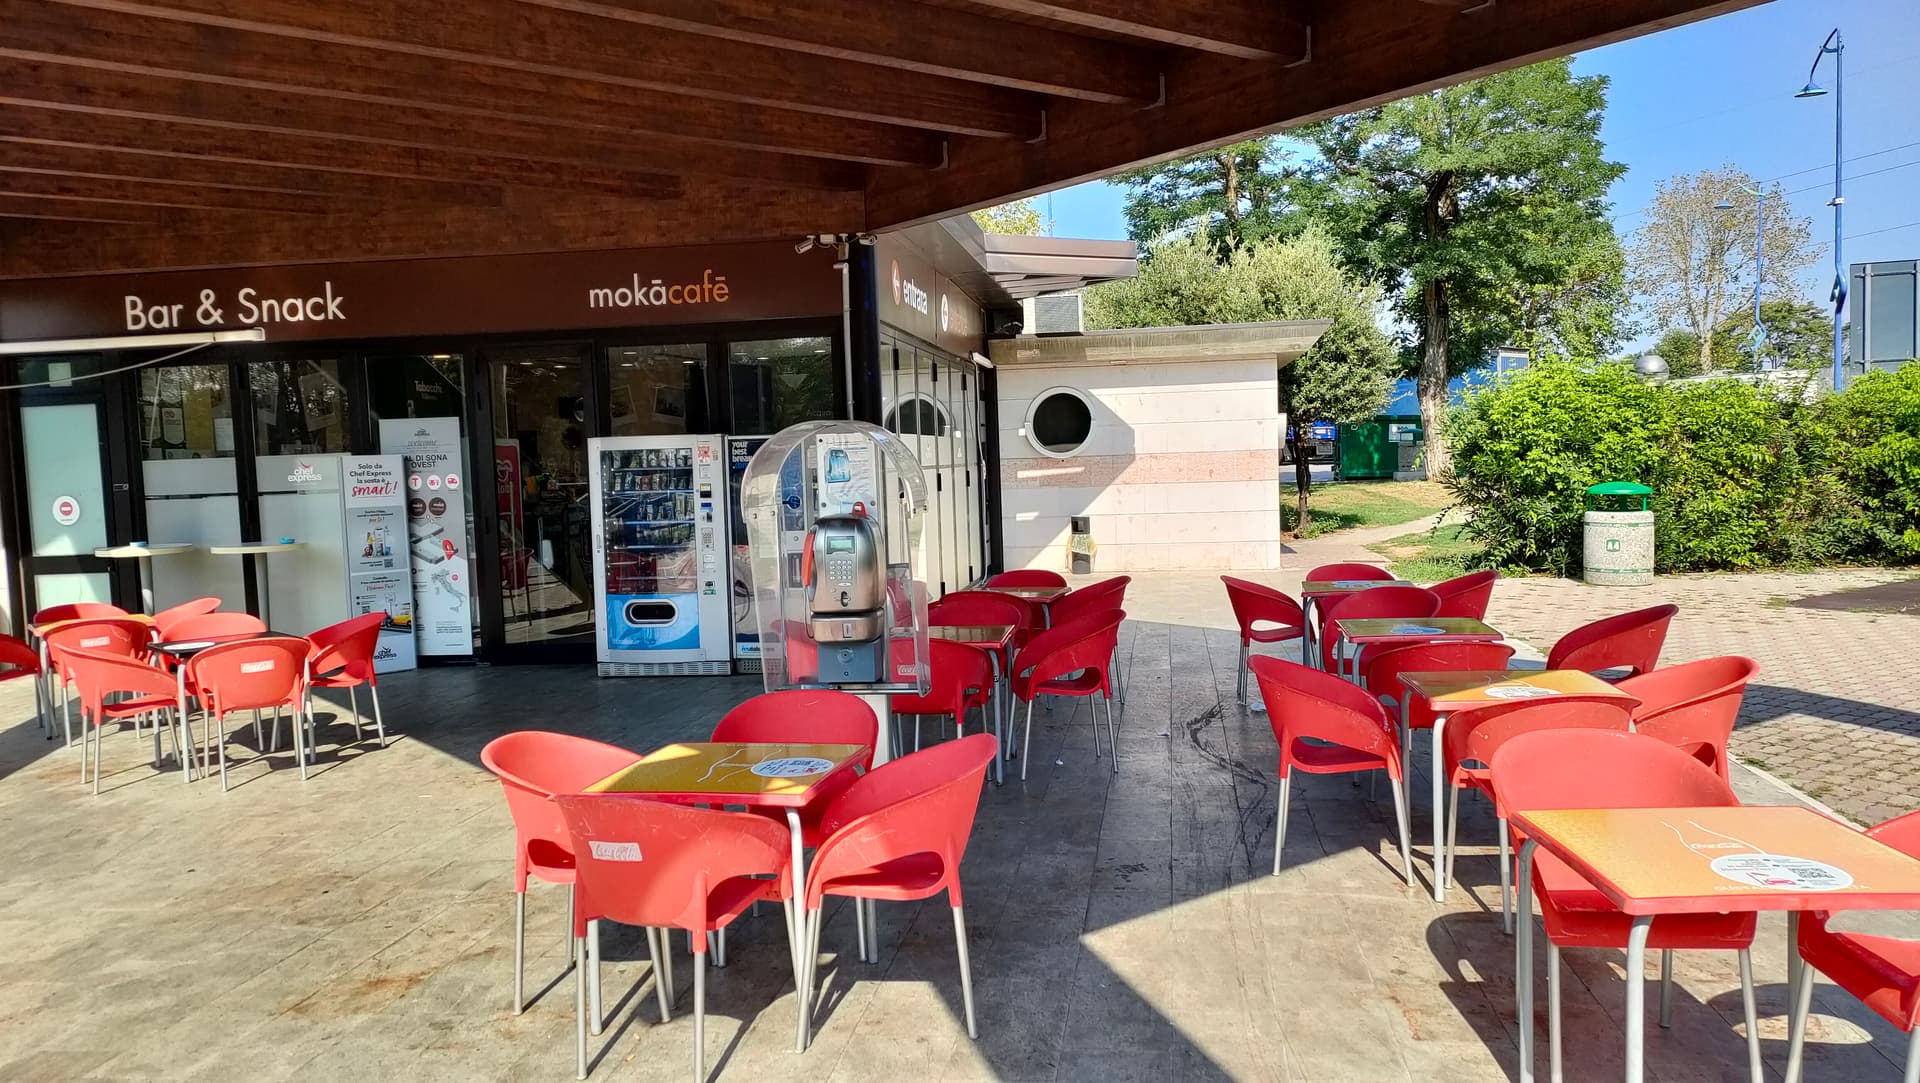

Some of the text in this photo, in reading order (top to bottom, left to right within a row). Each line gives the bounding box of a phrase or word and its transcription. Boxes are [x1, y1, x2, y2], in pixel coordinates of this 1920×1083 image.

[124, 281, 347, 331] Bar & Snack
[294, 466, 313, 475] chef
[288, 473, 322, 483] express
[352, 480, 398, 497] smart!
